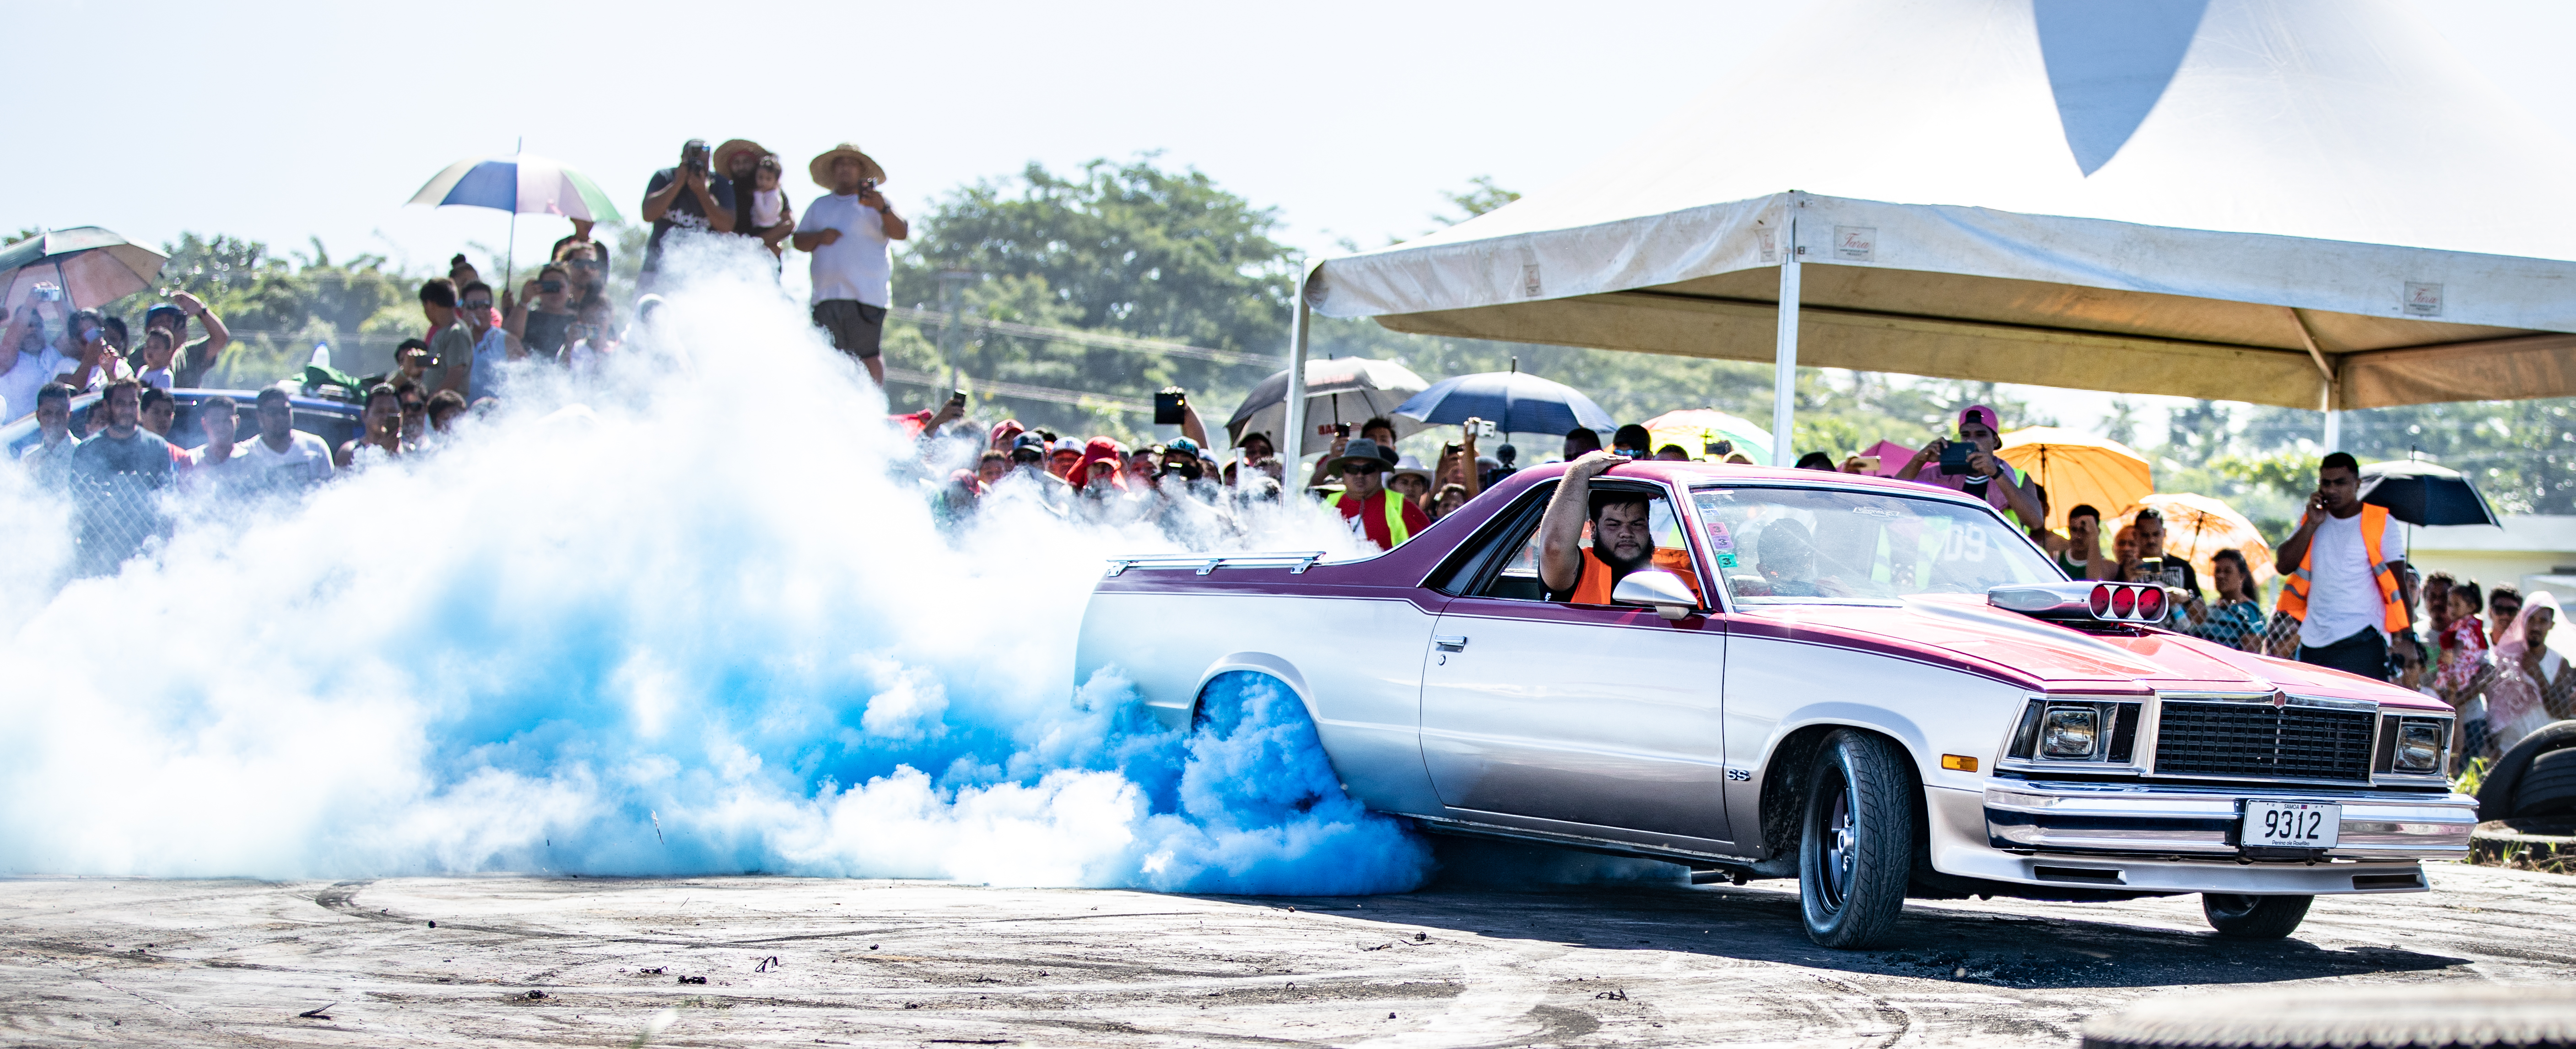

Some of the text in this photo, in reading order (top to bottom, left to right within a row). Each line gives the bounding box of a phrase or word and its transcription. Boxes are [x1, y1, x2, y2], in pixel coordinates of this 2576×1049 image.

[1839, 232, 1869, 248] Tara
[1944, 524, 1987, 561] 09
[1726, 769, 1748, 781] SS
[2265, 810, 2321, 839] 9312
